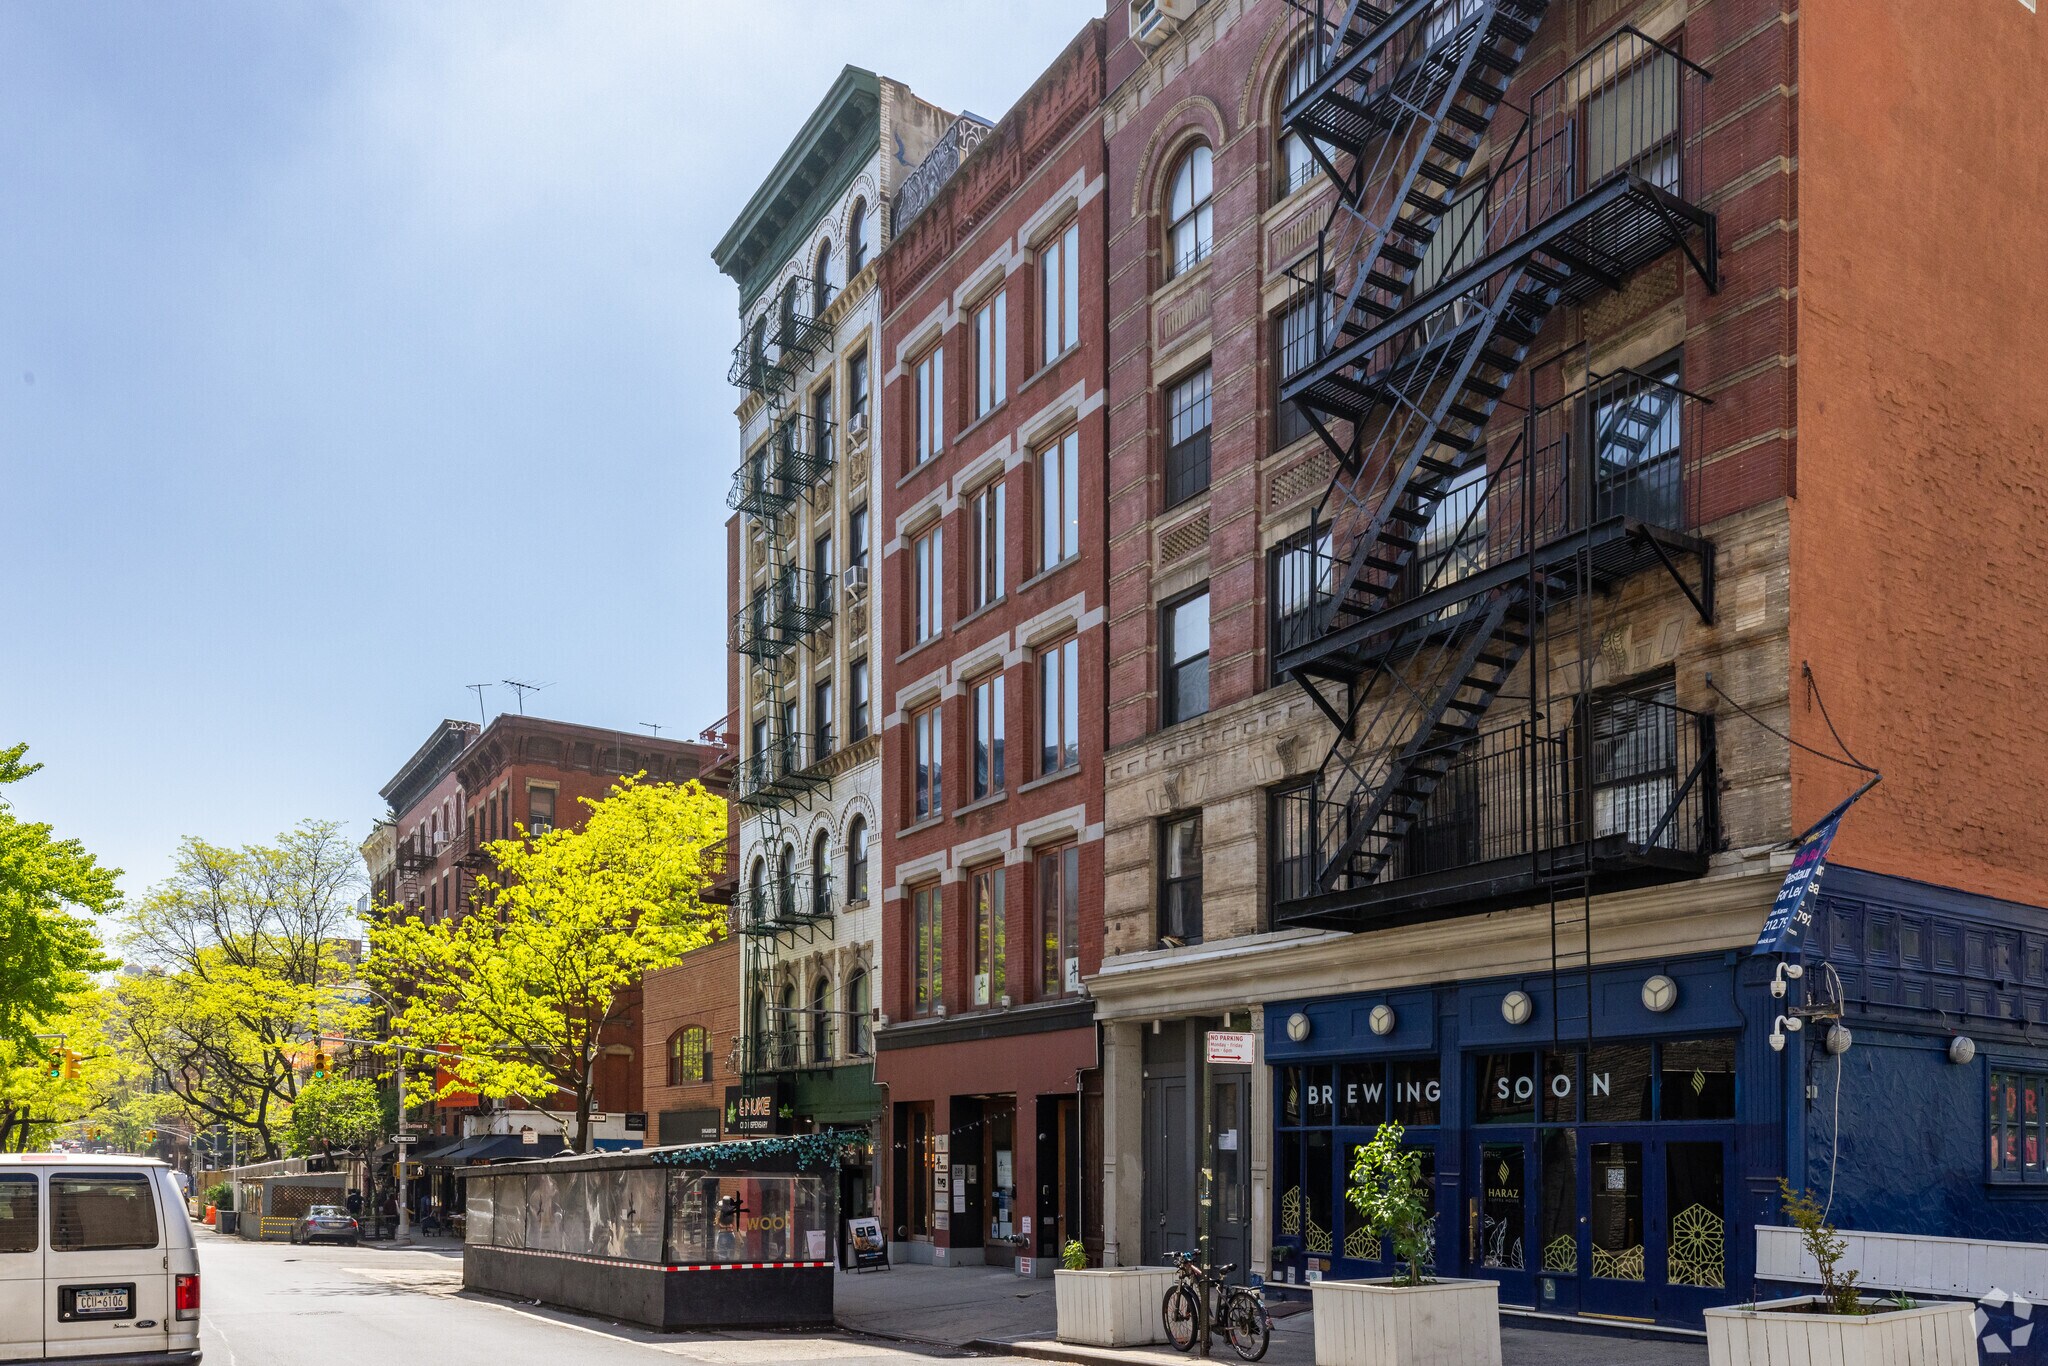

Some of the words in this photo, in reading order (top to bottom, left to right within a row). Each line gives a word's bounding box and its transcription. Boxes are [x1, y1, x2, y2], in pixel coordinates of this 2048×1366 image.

[1776, 889, 1789, 902] For
[1308, 1081, 1441, 1105] BREWING
[1497, 1072, 1610, 1100] SOON
[1488, 1188, 1519, 1199] HARAZ
